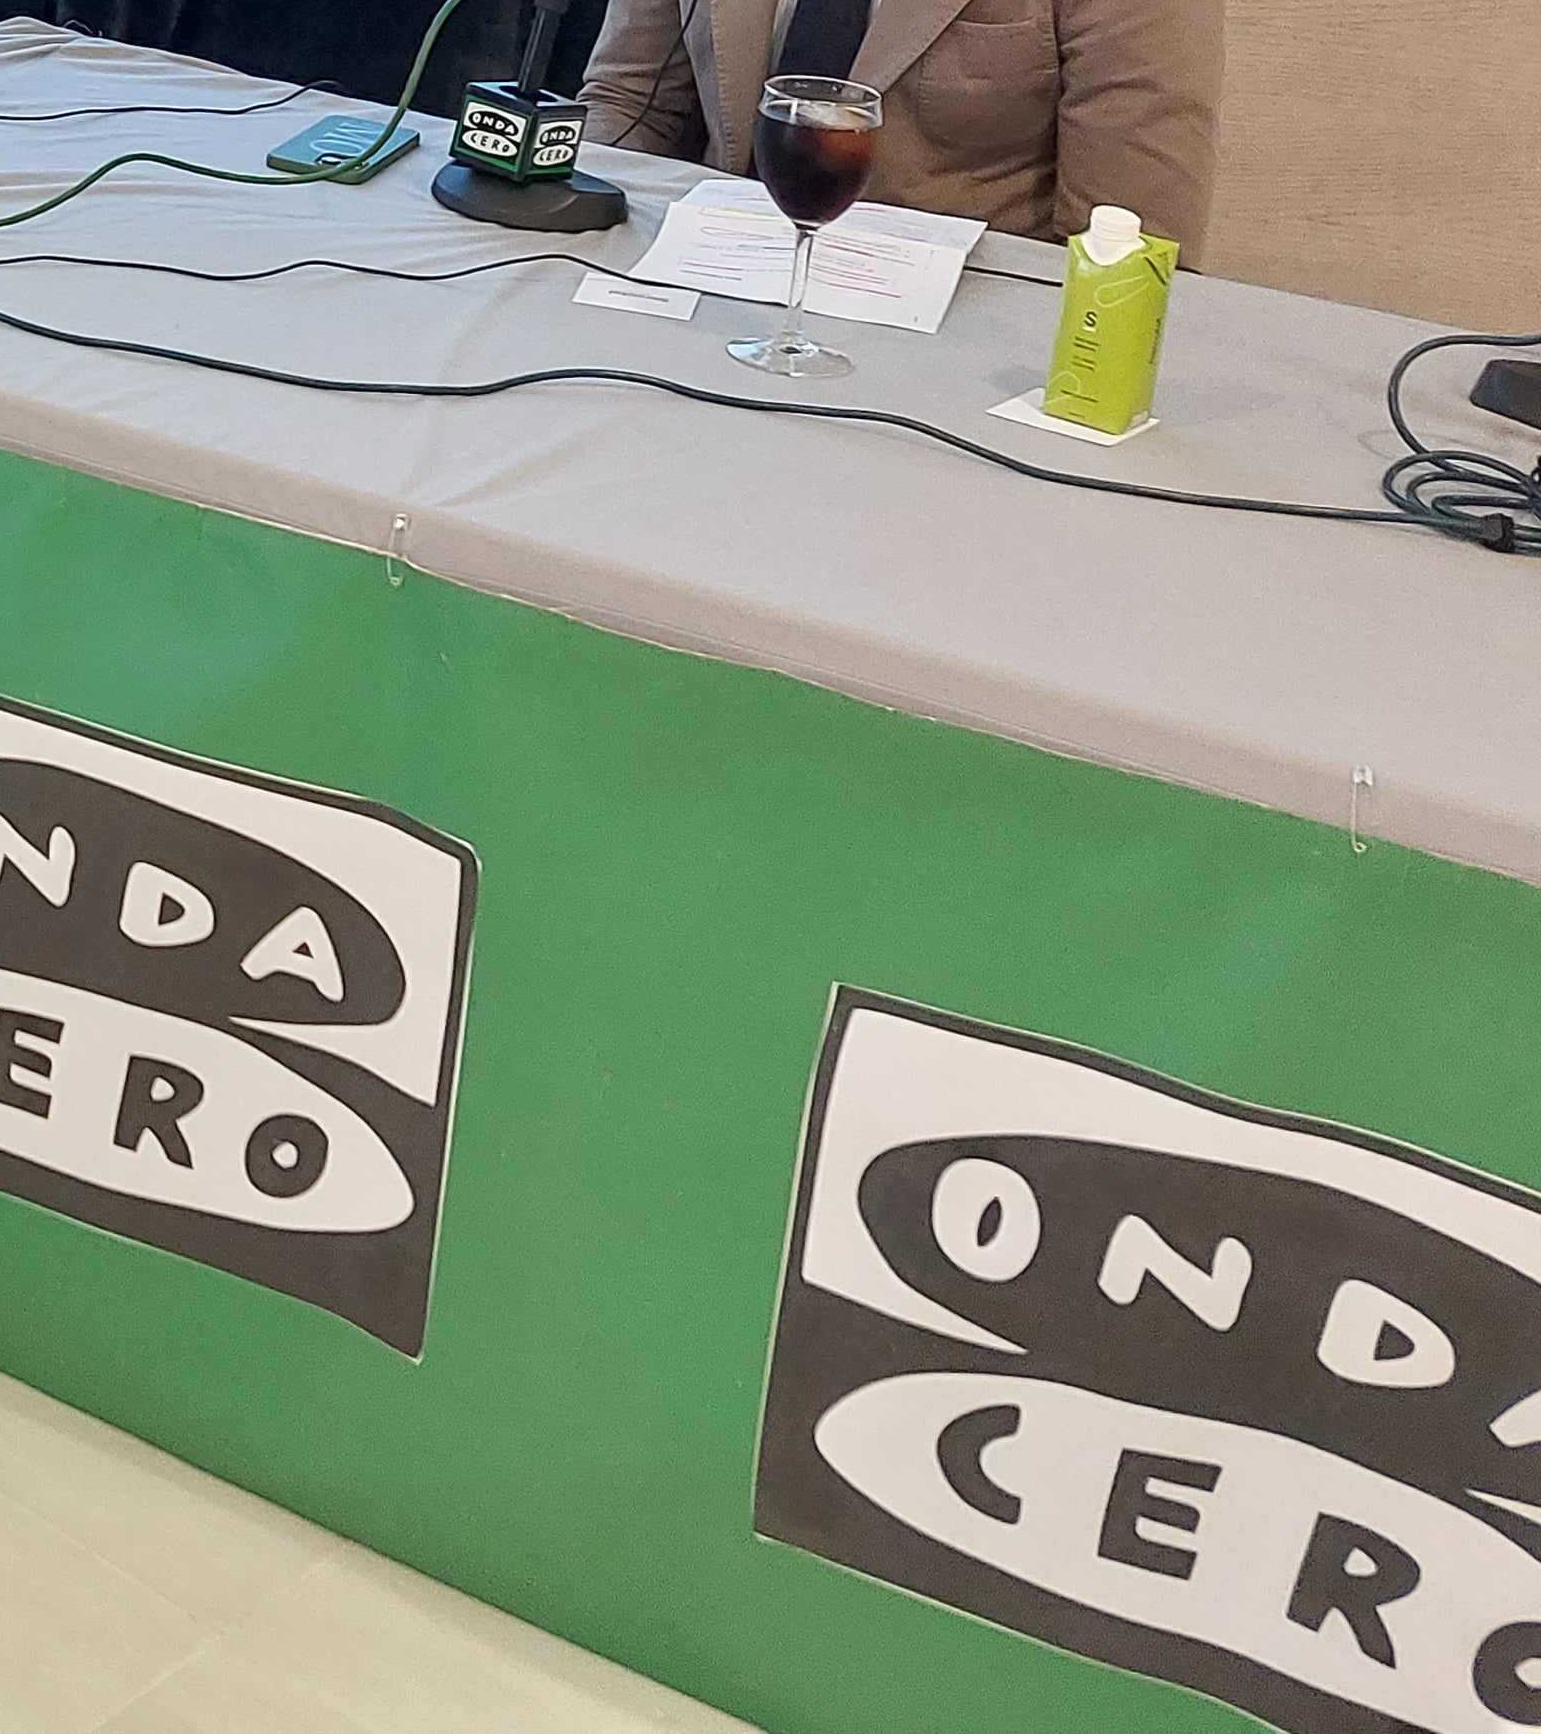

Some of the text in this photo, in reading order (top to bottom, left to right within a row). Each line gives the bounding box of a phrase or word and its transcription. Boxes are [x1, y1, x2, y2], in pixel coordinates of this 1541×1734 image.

[472, 113, 515, 134] ONDA
[470, 133, 510, 152] CERO
[541, 131, 573, 143] ONDA
[539, 149, 569, 162] CERO
